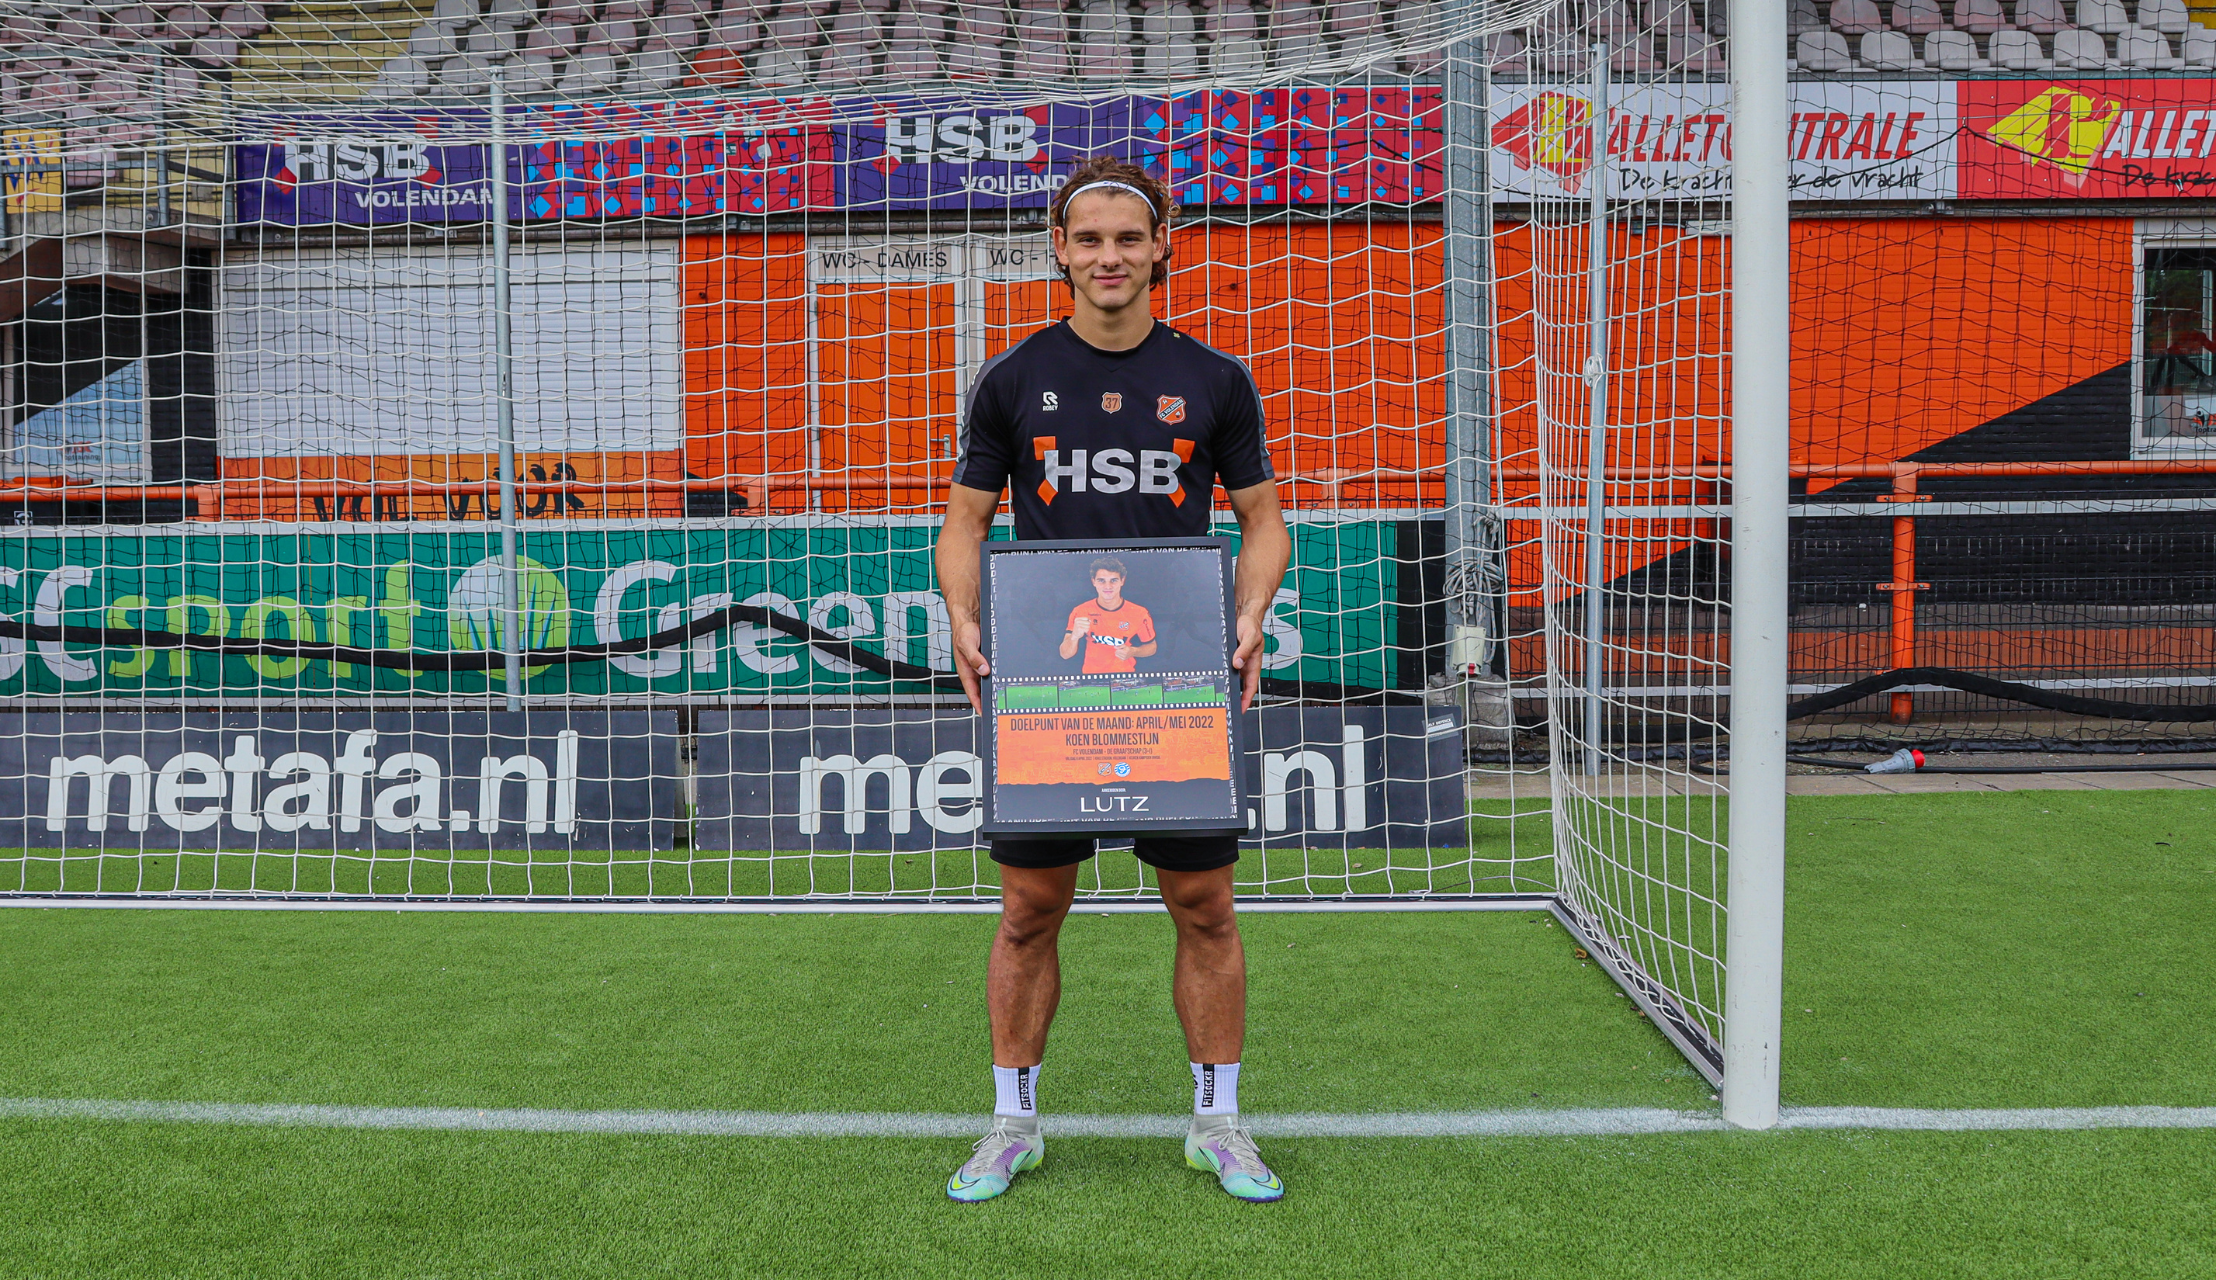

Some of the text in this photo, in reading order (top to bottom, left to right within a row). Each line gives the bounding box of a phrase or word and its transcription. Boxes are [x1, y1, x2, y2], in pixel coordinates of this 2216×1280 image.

[886, 115, 1039, 164] HSB
[285, 134, 431, 181] HSB
[822, 252, 857, 269] WC
[878, 252, 948, 268] DAMES
[990, 249, 1024, 266] WC
[1044, 449, 1182, 494] HSB
[1010, 715, 1214, 731] DOELPUNT VAN DE MAAND: APRIL/MEI 2022
[1065, 732, 1159, 746] KOEN BLOMMESTIJN
[46, 729, 578, 835] metafa.nl
[1080, 796, 1150, 813] LUTZ
